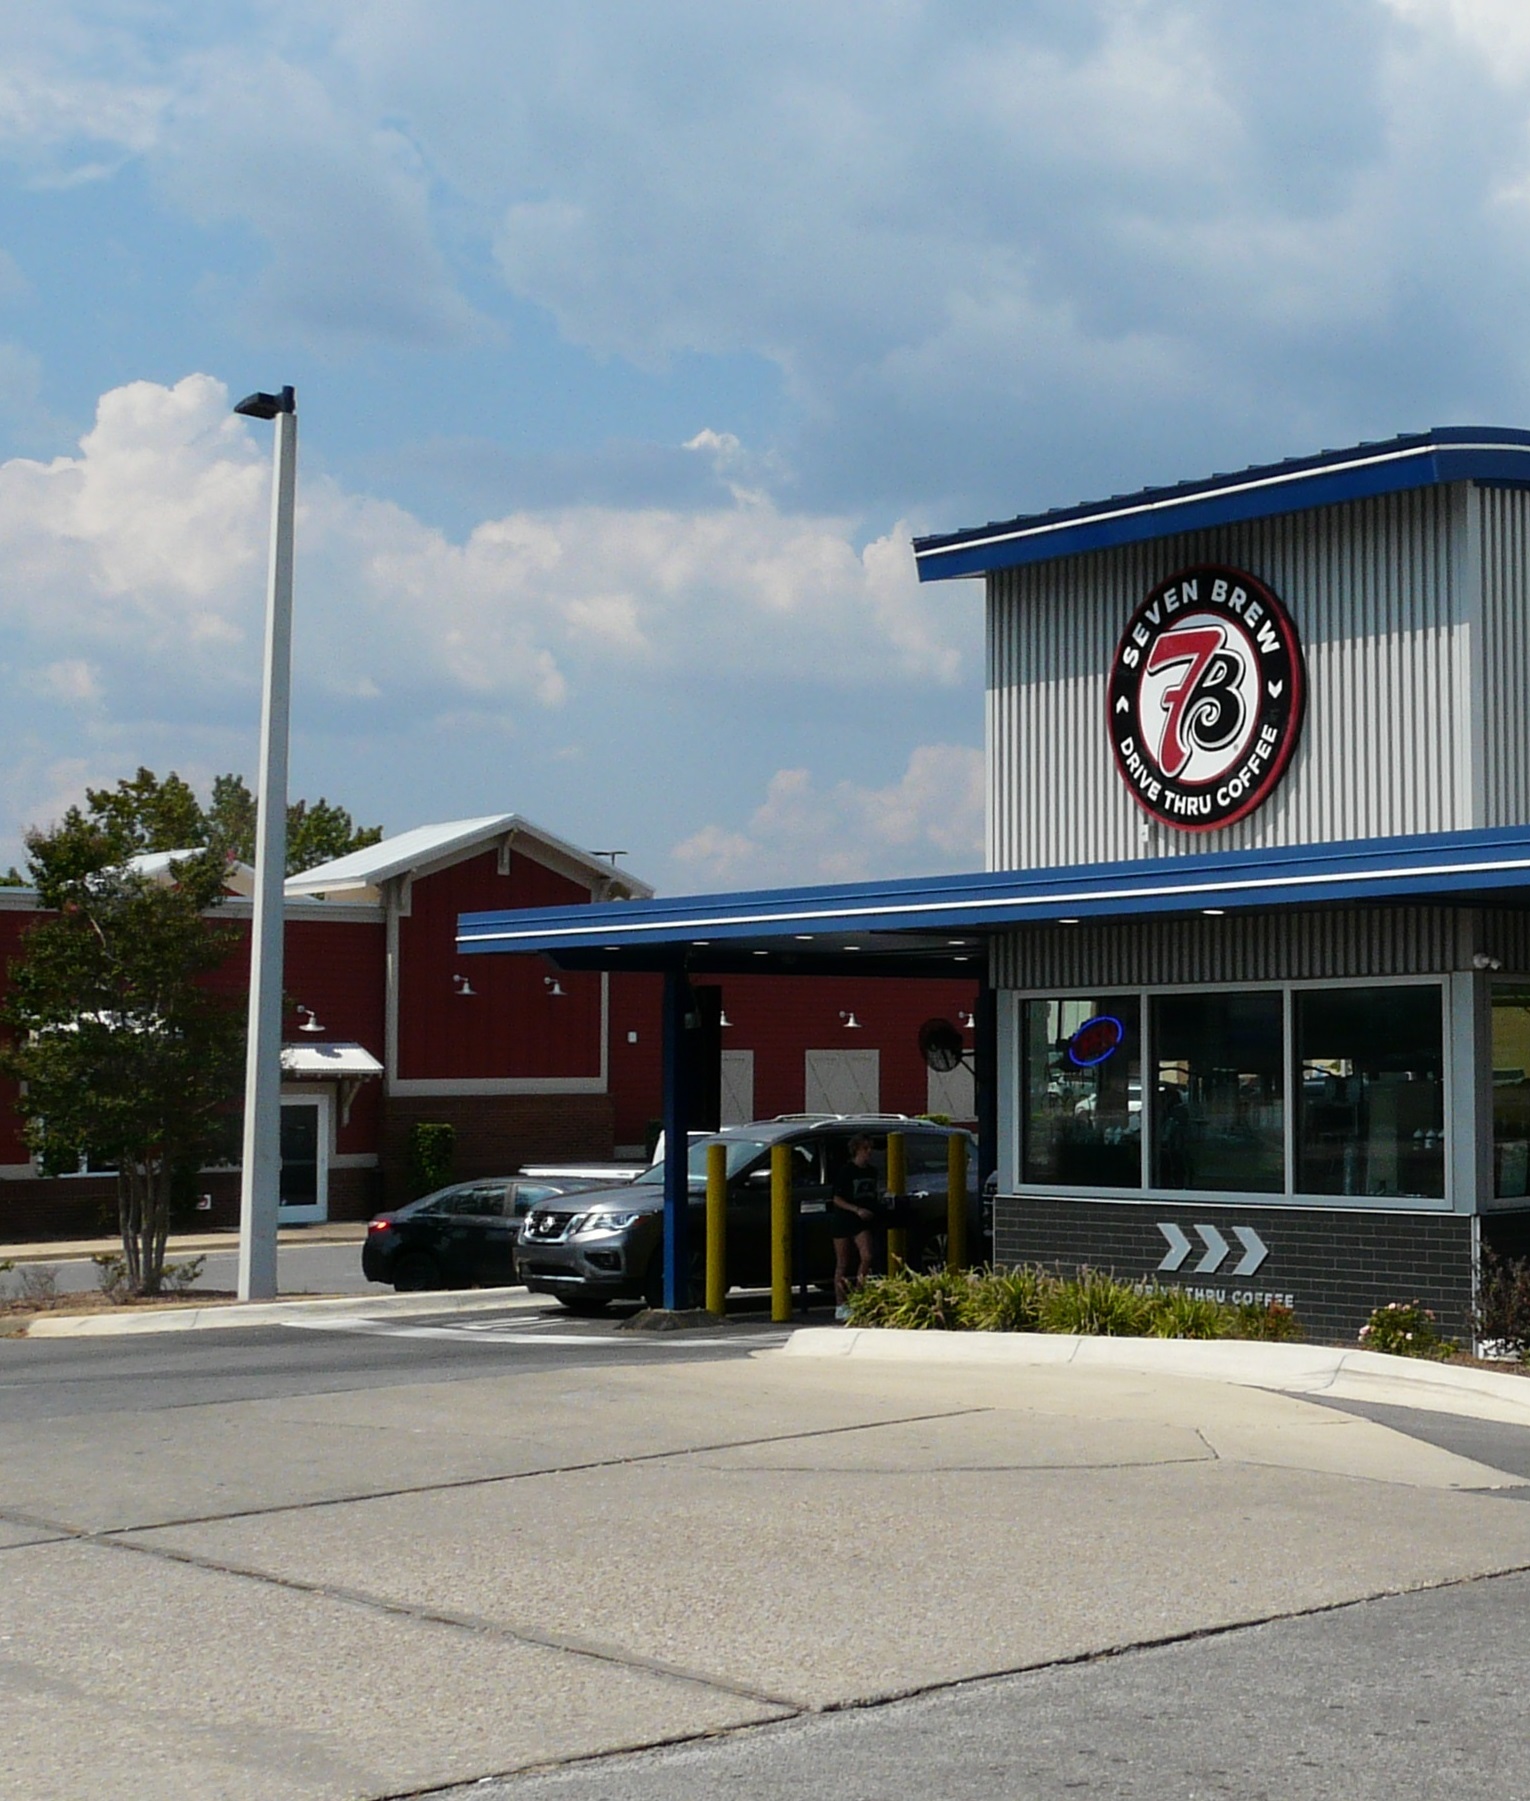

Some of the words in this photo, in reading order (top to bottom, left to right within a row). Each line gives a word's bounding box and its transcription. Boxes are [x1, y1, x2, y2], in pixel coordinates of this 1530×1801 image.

[1122, 578, 1199, 669] SEVEN
[1210, 579, 1282, 654] BREW
[1120, 735, 1160, 801] DRIVE
[1163, 790, 1211, 816] THRU
[1216, 724, 1277, 806] COFFEE
[1185, 1287, 1225, 1303] THRU
[1232, 1291, 1294, 1309] COFFEE
